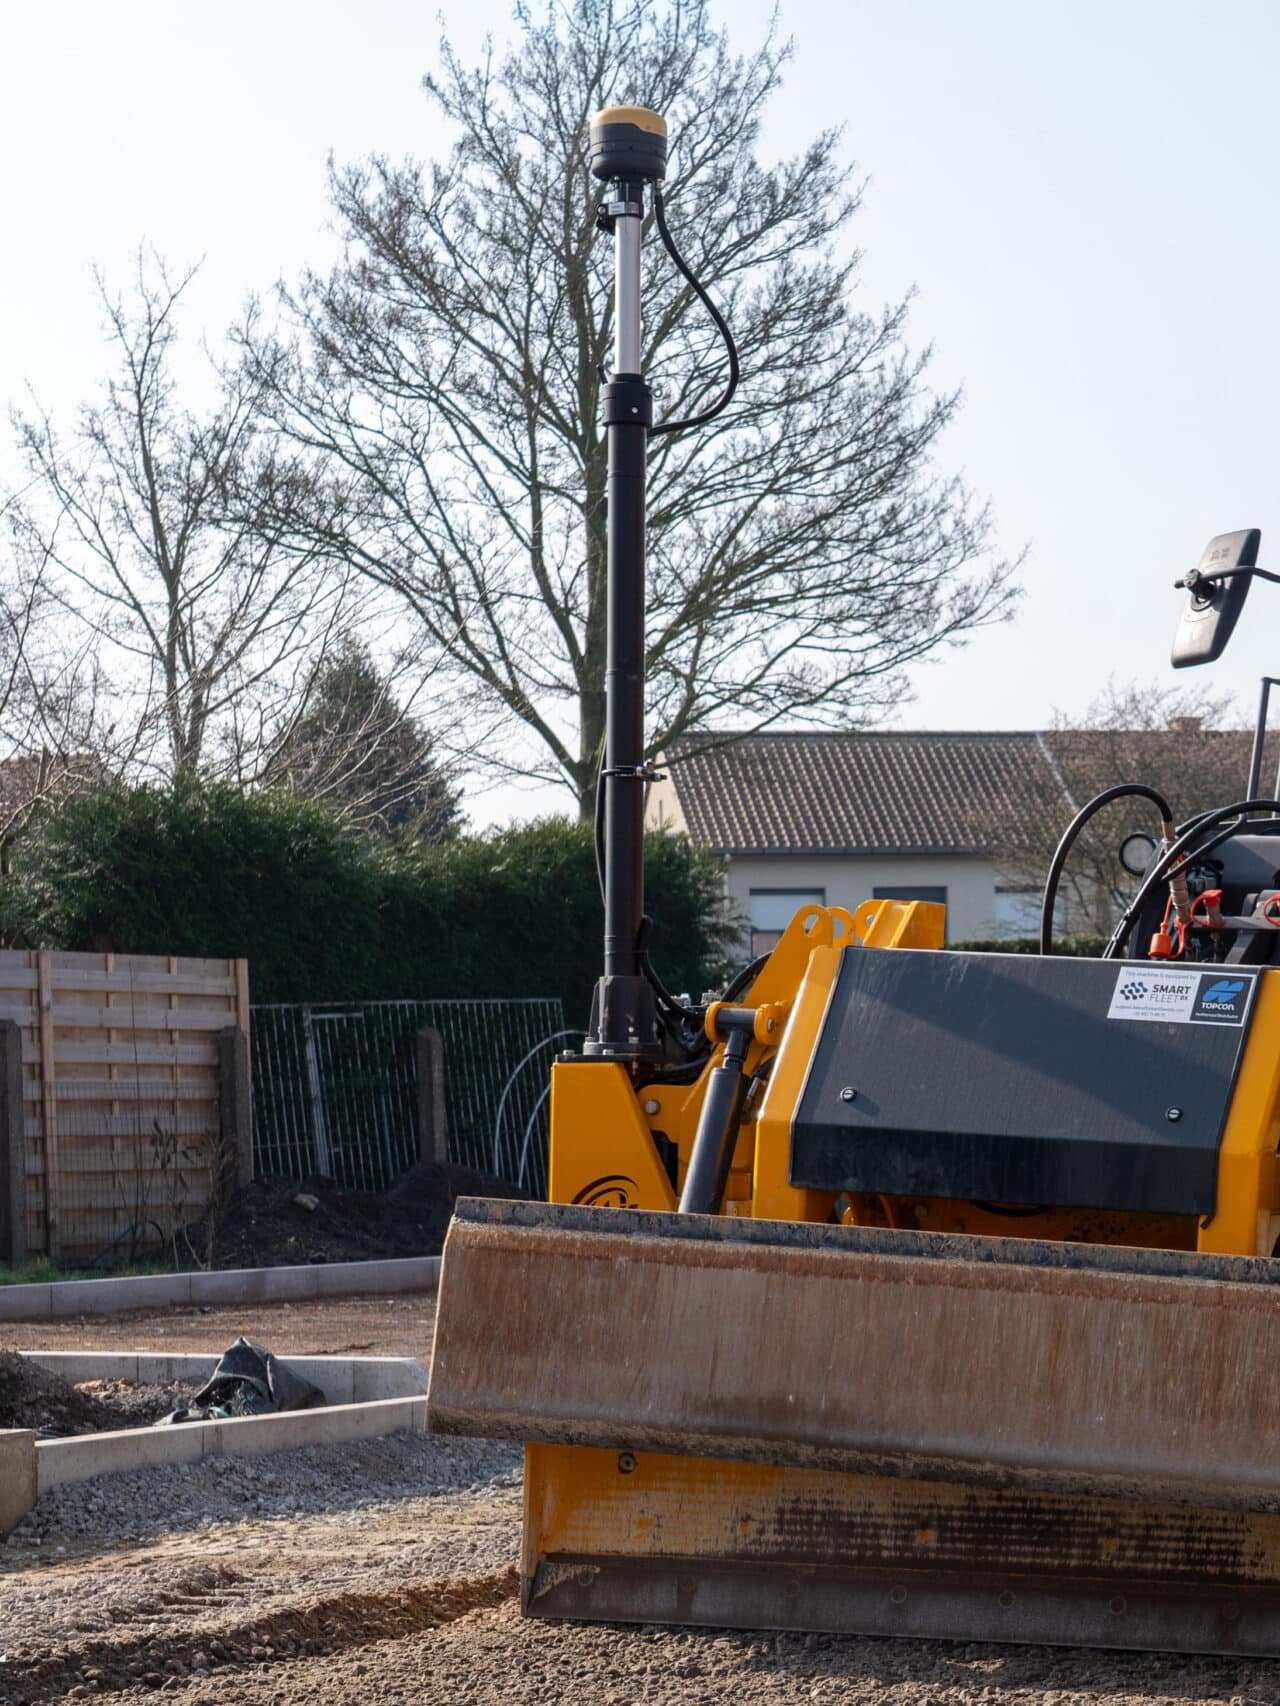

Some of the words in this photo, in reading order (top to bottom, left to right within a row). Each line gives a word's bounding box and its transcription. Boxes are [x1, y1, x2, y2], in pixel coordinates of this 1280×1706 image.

[1152, 984, 1192, 995] SMART
[1149, 993, 1180, 1003] FLEET
[1201, 1002, 1235, 1011] TOPCON
